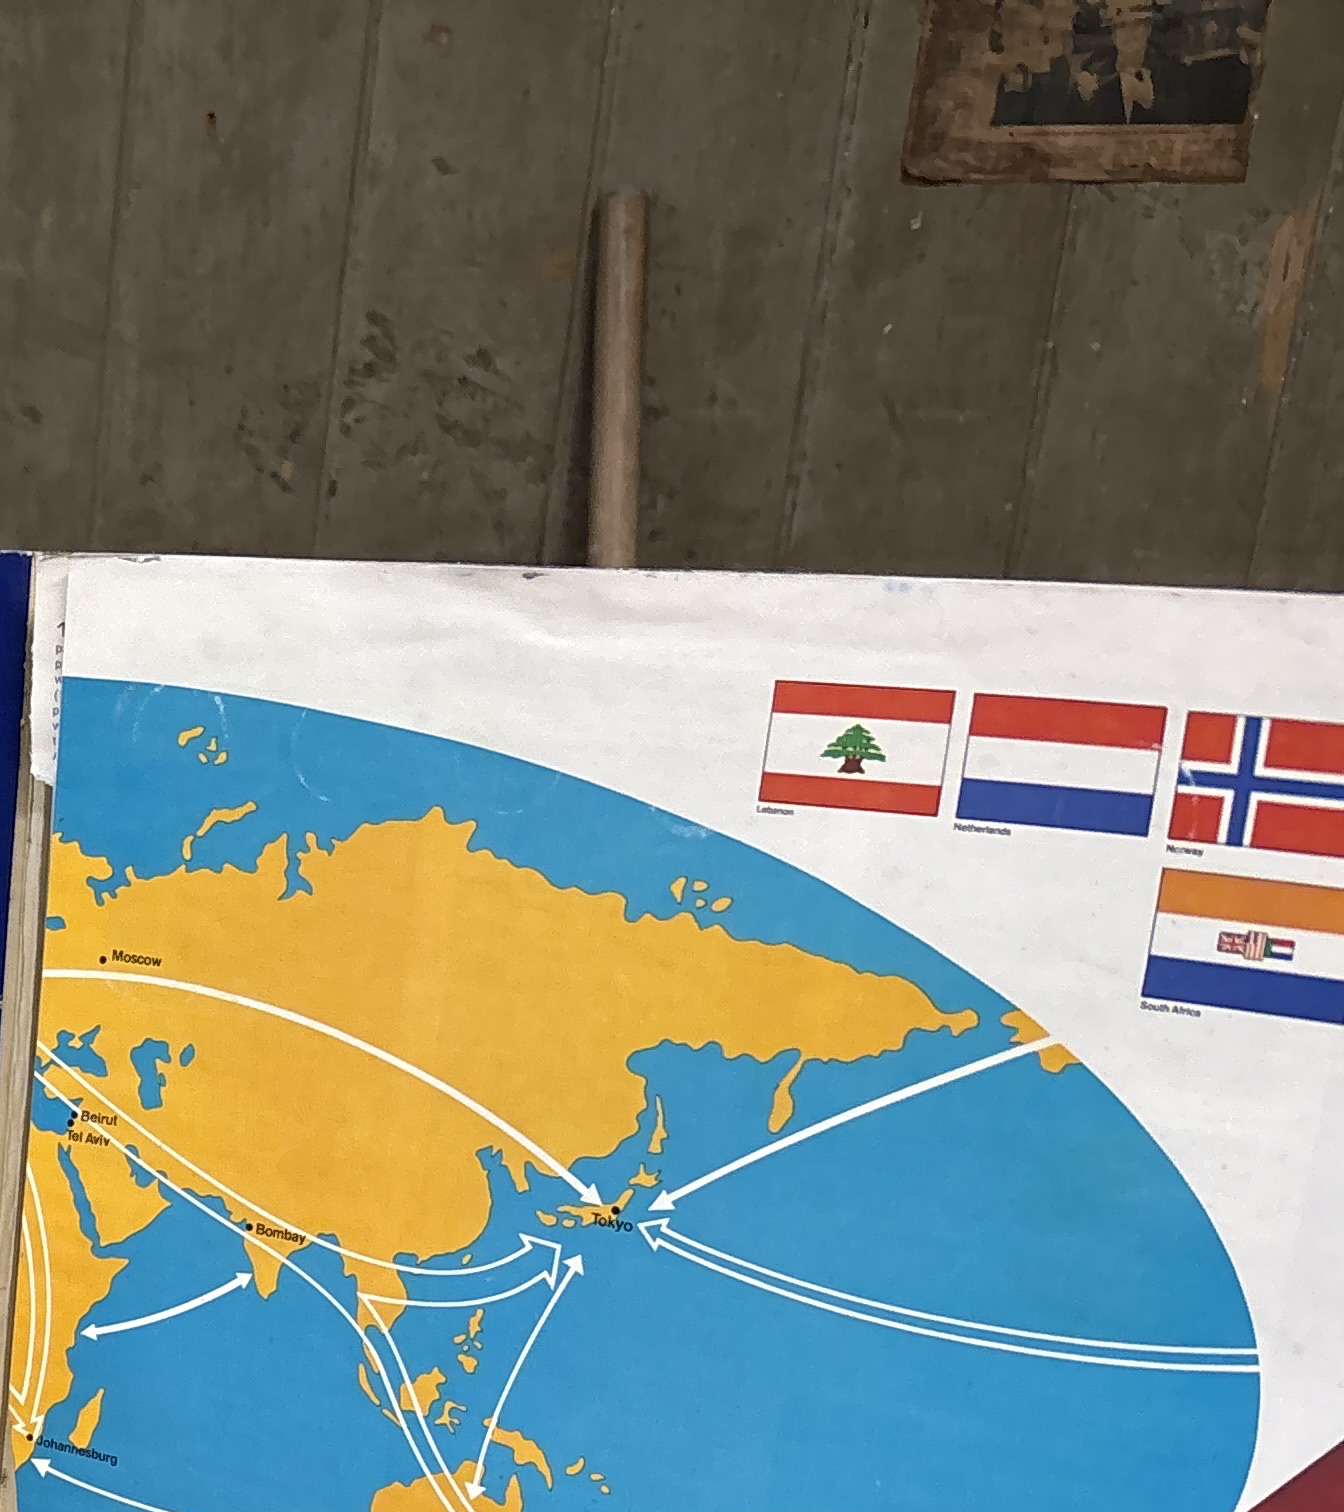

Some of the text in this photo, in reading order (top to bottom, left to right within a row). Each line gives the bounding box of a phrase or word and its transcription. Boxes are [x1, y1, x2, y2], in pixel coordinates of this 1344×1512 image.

[112, 949, 162, 968] Moscow
[81, 1110, 119, 1126] Beirut
[68, 1130, 111, 1146] Tel Aviv
[591, 1212, 633, 1232] Tokyo
[256, 1223, 306, 1245] Bombay
[36, 1436, 118, 1467] Johannesburg
